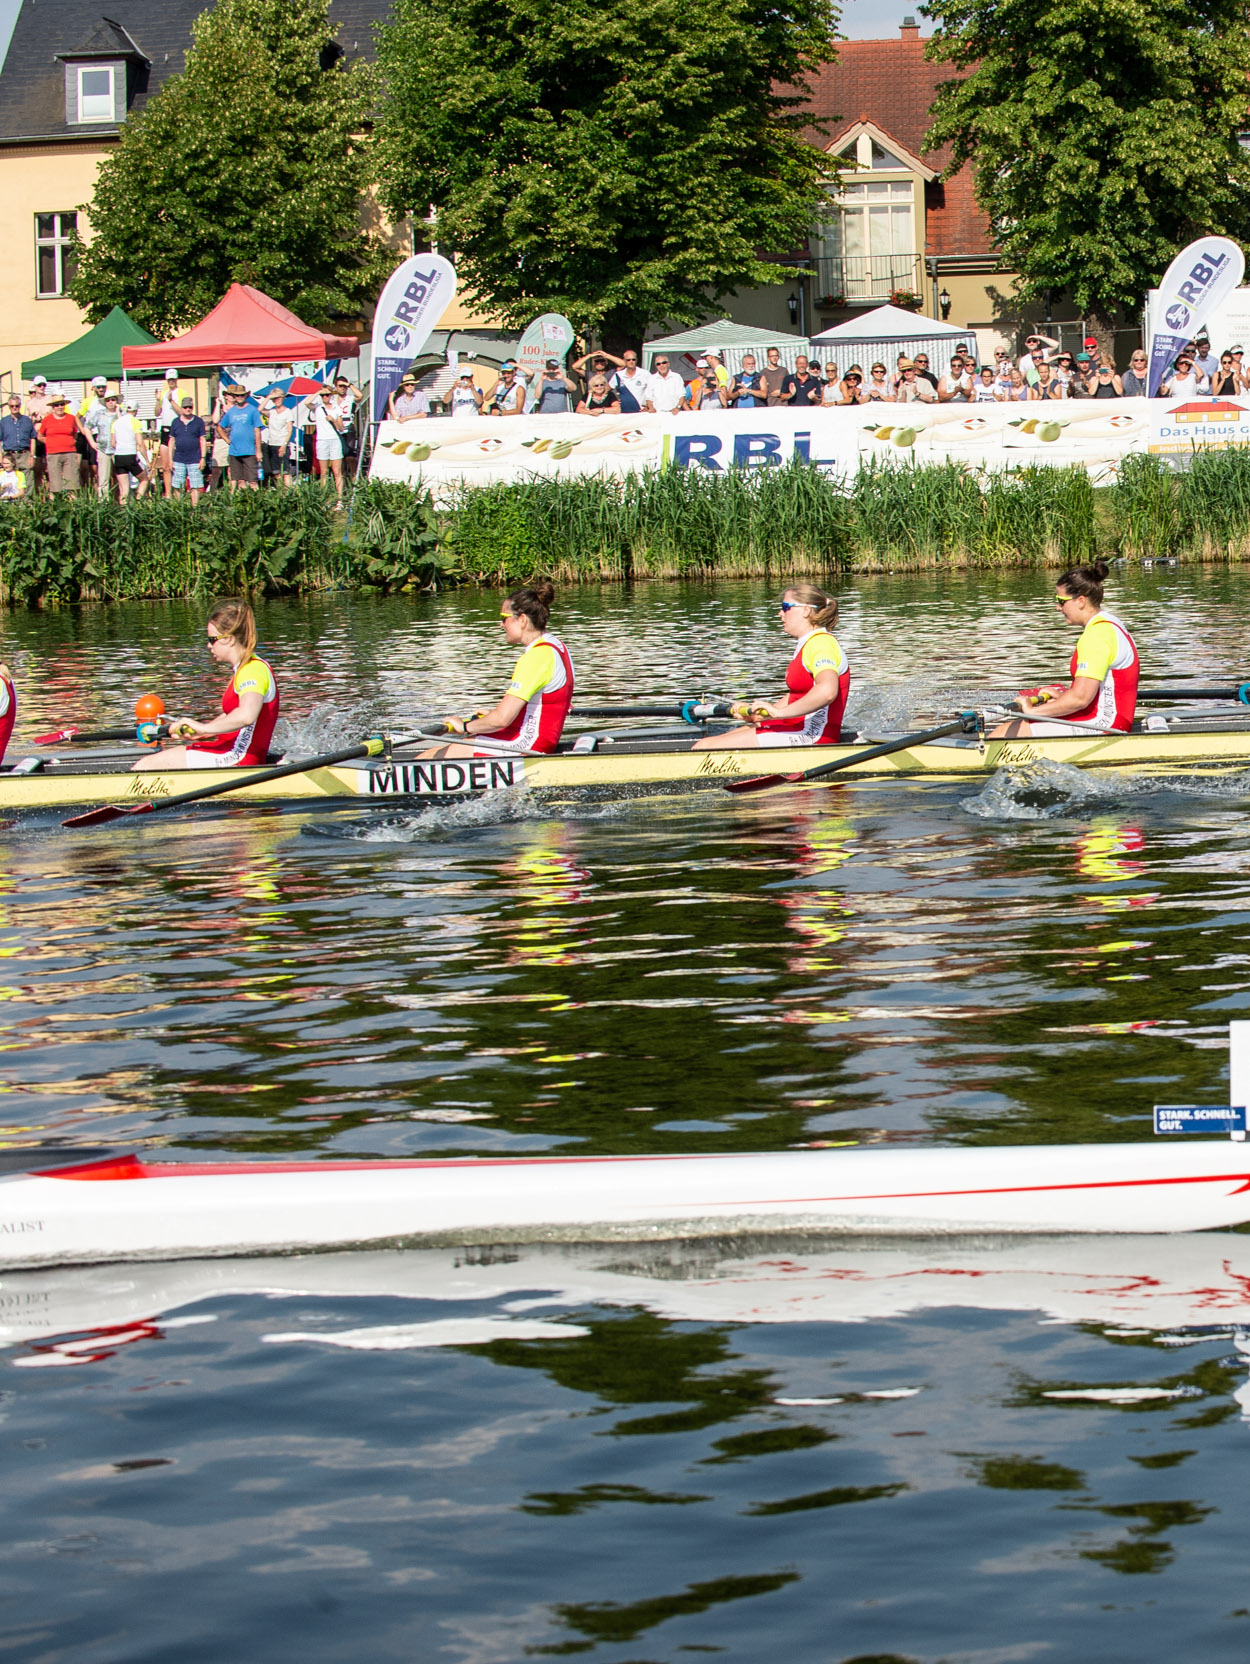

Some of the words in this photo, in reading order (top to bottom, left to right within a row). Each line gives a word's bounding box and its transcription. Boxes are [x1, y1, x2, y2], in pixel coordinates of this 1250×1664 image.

[1177, 252, 1226, 305] RBL
[395, 269, 437, 323] RBL
[522, 345, 540, 355] 100
[1160, 427, 1189, 437] Das
[1195, 426, 1235, 436] Haus
[674, 431, 836, 471] RBL
[695, 753, 742, 775] Melitta
[990, 742, 1038, 766] Melitta
[126, 775, 170, 796] Melitta
[369, 761, 514, 793] MINDEN
[1159, 1109, 1194, 1120] STARK.
[1194, 1109, 1241, 1120] SCHNELL.
[1159, 1120, 1183, 1130] GUT.
